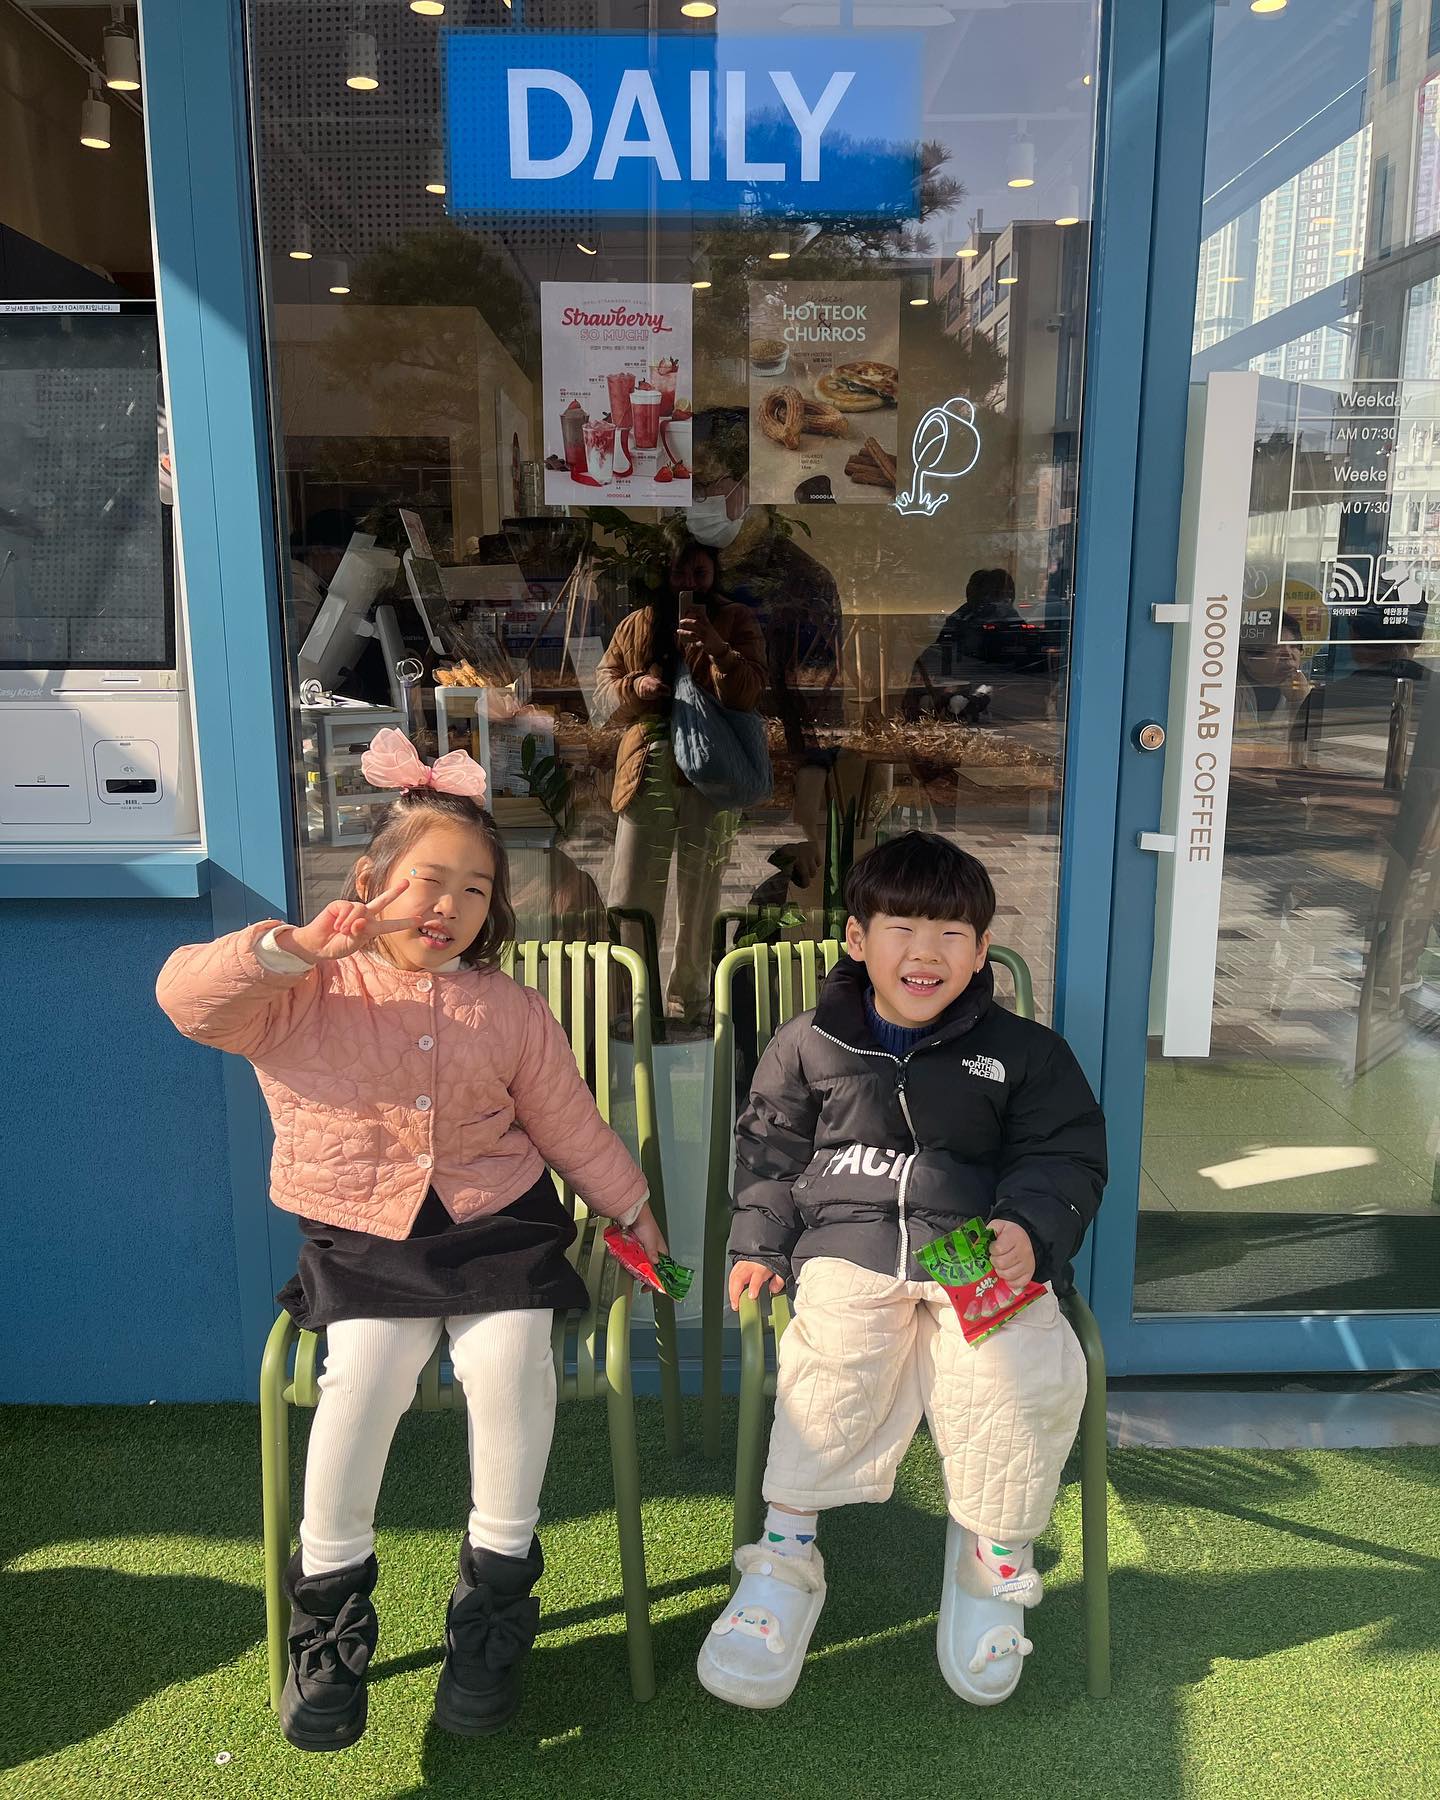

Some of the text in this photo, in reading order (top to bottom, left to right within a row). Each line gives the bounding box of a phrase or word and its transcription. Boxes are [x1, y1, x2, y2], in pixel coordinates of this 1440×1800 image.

[506, 68, 857, 182] DAILY
[783, 305, 868, 321] HOTTEOK
[561, 306, 673, 334] Strawberry
[580, 329, 649, 341] SO MUCH!
[783, 326, 867, 342] CHURROS
[1340, 391, 1412, 410] Weekday
[1336, 427, 1358, 440] AM
[1361, 427, 1396, 440] 07:30
[1333, 466, 1406, 482] Weeked
[1353, 502, 1389, 514] 07:30
[1242, 610, 1272, 625] 세요
[1332, 607, 1358, 616] 와이파이
[1383, 607, 1409, 616] 애완동물
[1382, 616, 1408, 625] 출입불가
[1240, 627, 1266, 639] USH
[0, 687, 44, 698] asy Kiosk
[1188, 752, 1217, 862] COFFEE
[961, 1058, 992, 1072] NORTH
[976, 1054, 994, 1064] THE
[968, 1067, 991, 1079] FACE
